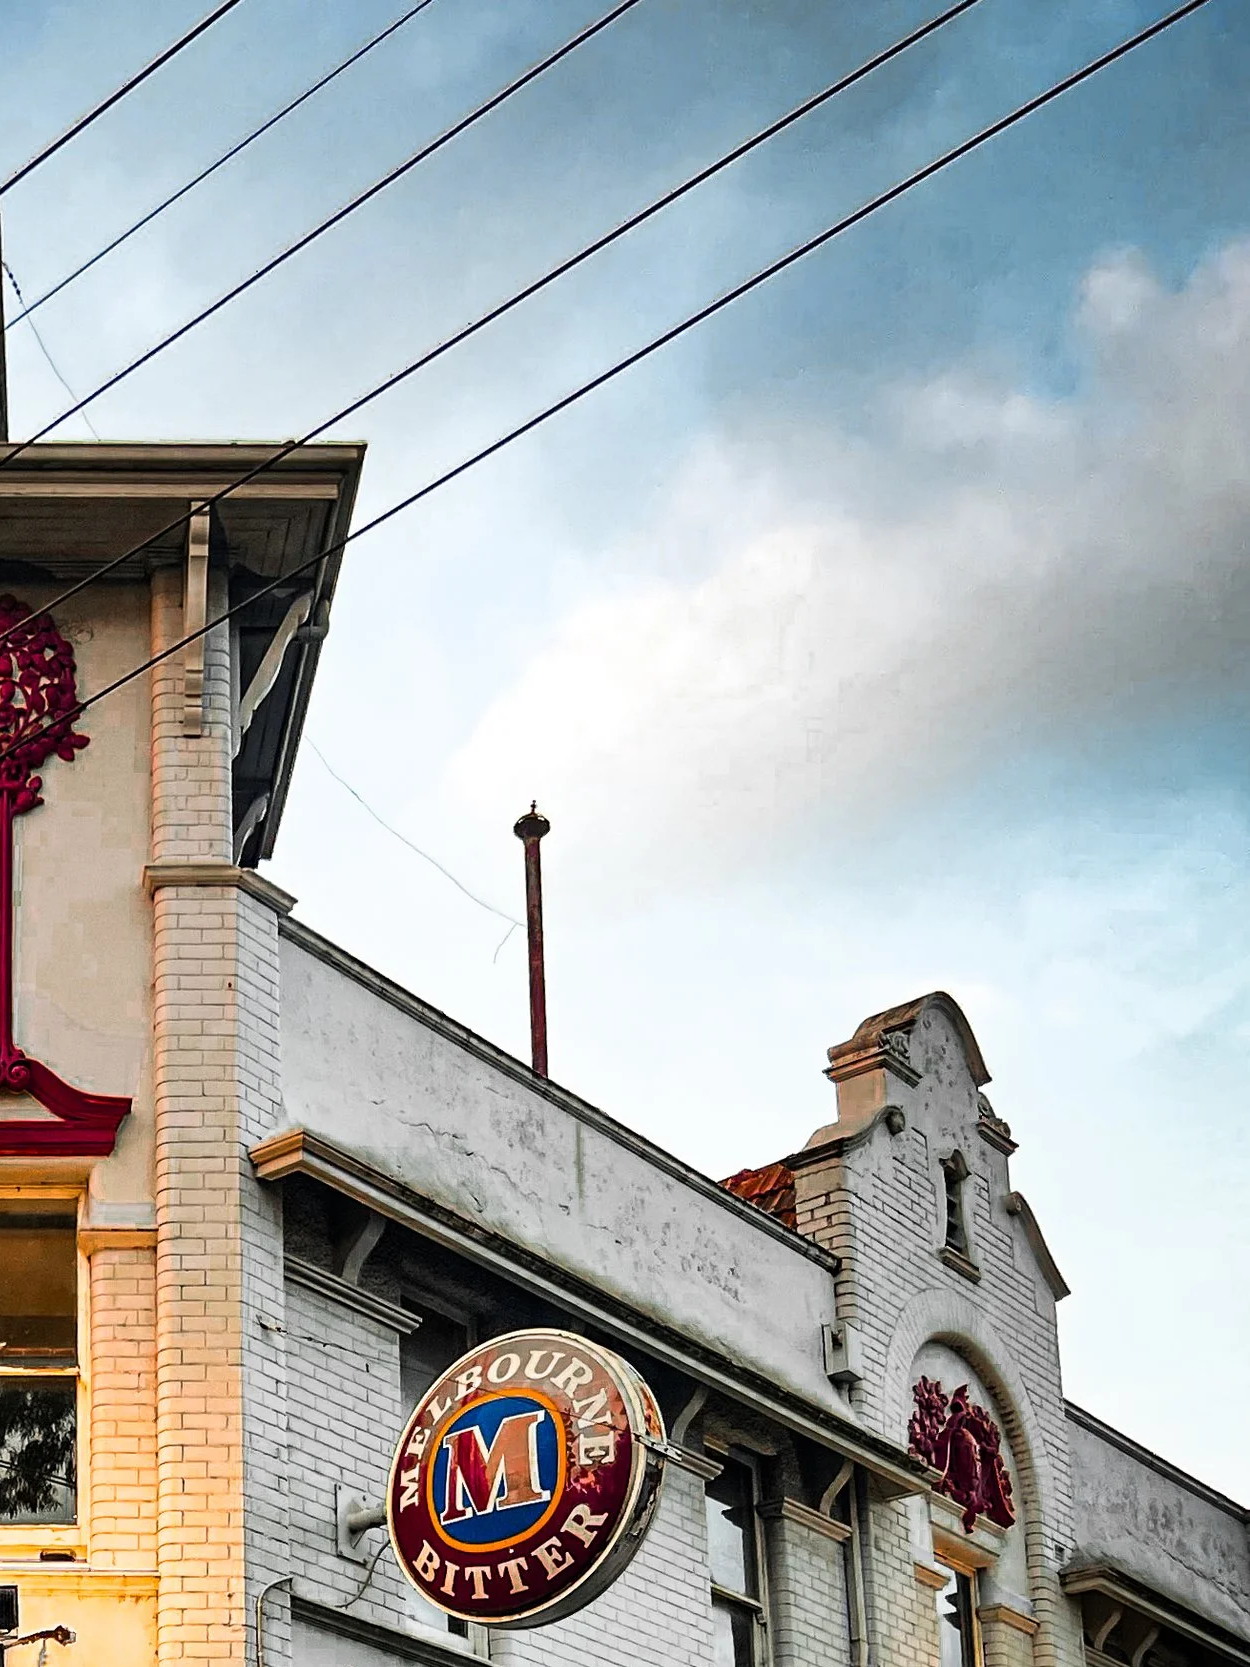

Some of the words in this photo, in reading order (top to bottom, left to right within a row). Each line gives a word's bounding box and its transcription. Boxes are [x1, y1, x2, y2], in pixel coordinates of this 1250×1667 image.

[400, 1350, 616, 1512] MELBOURNE
[440, 1409, 551, 1526] M
[412, 1503, 609, 1600] BITTER
